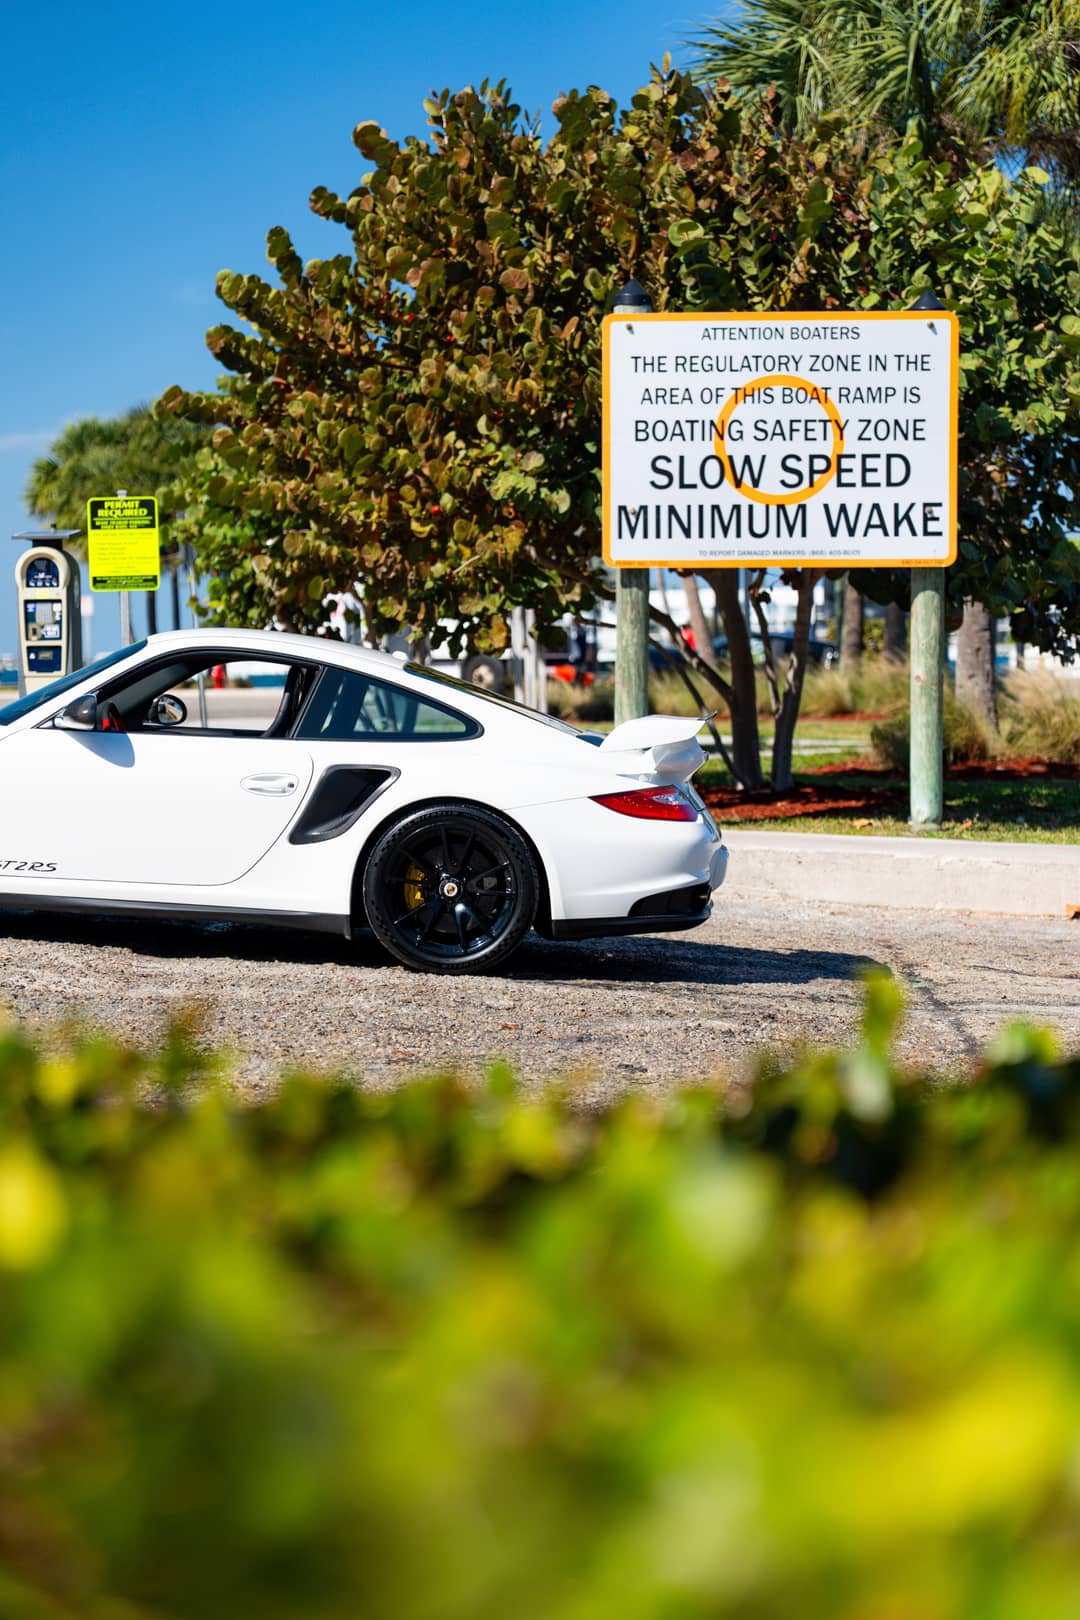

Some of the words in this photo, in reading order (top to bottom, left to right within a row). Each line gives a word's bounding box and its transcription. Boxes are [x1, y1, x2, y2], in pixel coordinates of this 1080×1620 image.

[702, 327, 784, 341] ATTENTION
[790, 326, 861, 340] BOATERS
[631, 355, 668, 373] THE
[674, 355, 803, 372] REGULATORY
[809, 355, 862, 372] ZONE
[868, 355, 887, 372] IN
[894, 354, 931, 371] THE
[640, 387, 694, 405] AREA
[700, 387, 726, 404] OF
[731, 387, 775, 404] THIS
[782, 387, 832, 404] BOAT
[838, 386, 897, 404] RAMP
[903, 386, 921, 404] IS
[634, 419, 744, 442] BOATING
[753, 419, 850, 441] SAFETY
[857, 418, 927, 441] ZONE
[649, 454, 767, 490] SLOW
[779, 453, 912, 489] SPEED
[97, 508, 148, 518] REQUIRED
[104, 501, 140, 509] PERMIT
[617, 503, 808, 540] MINIMUM
[823, 502, 944, 538] WAKE
[709, 549, 736, 557] REPORT
[0, 860, 57, 872] T2RS
